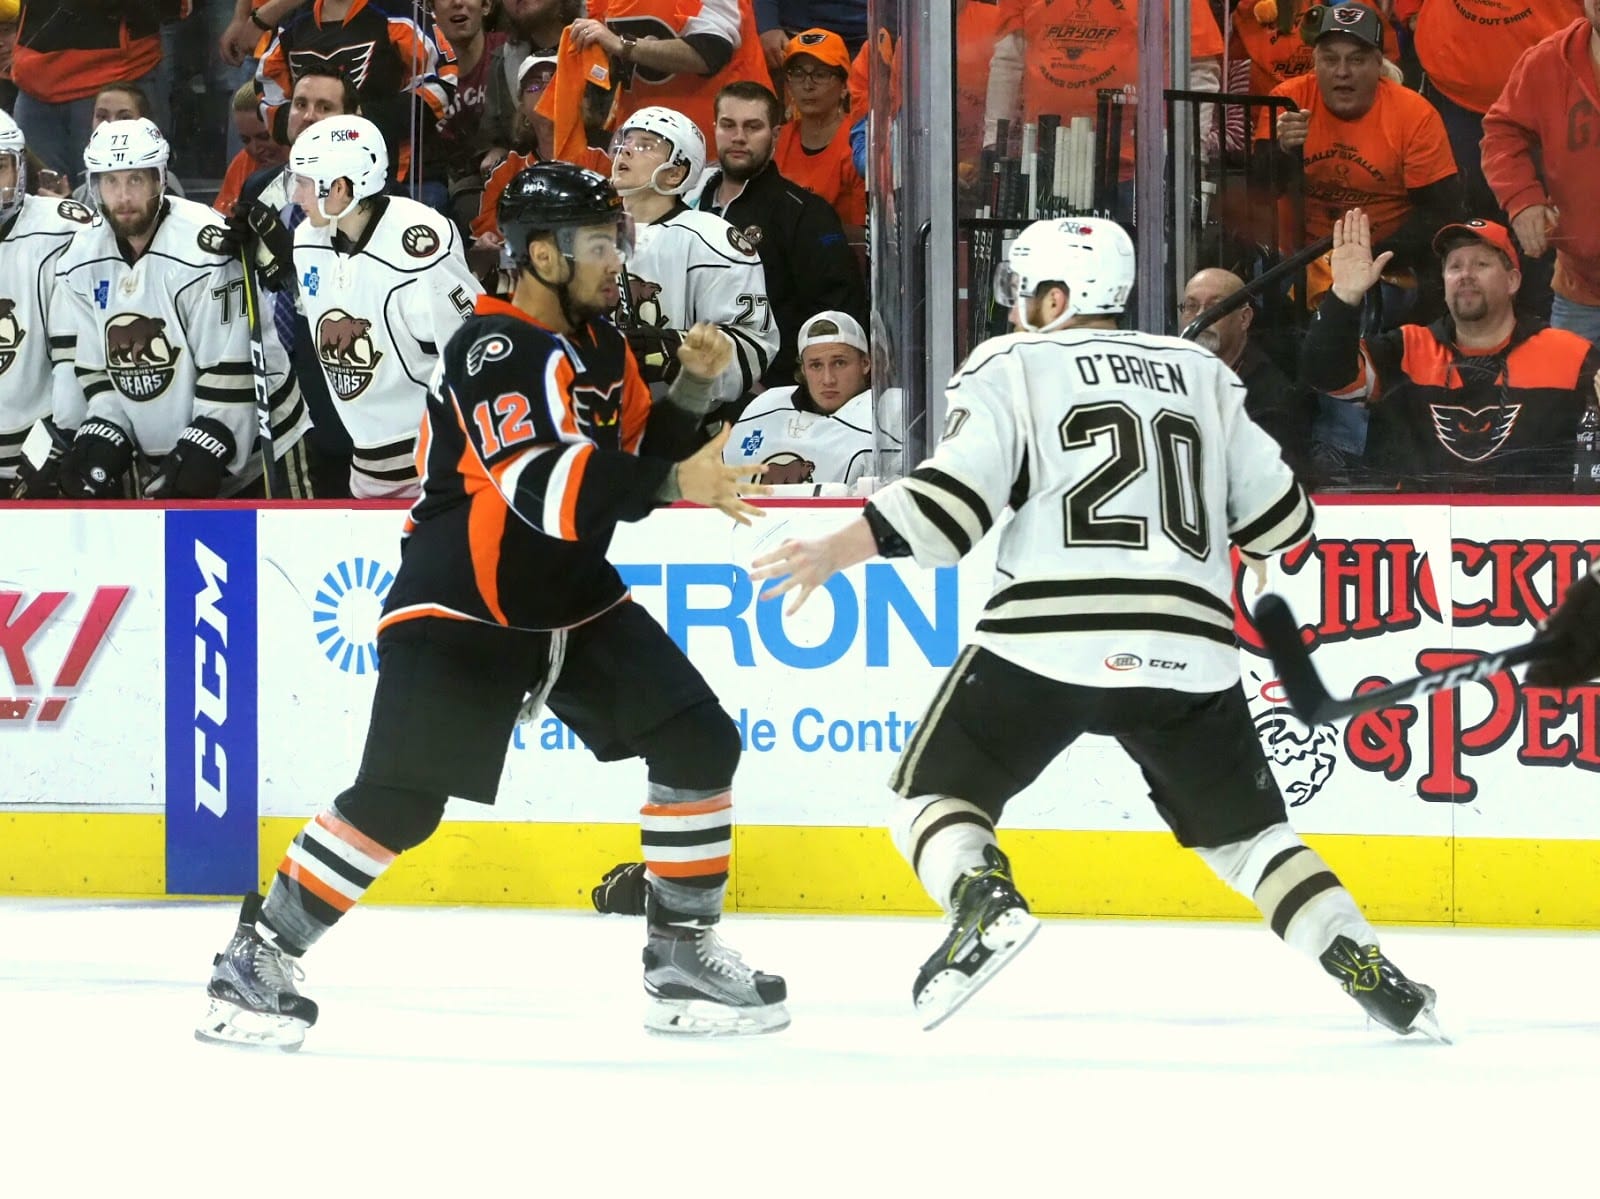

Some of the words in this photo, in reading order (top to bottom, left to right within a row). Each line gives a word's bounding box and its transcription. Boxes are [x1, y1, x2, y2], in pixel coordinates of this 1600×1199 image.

[1046, 26, 1117, 39] PLAYOFF
[1478, 17, 1500, 25] OUT
[111, 134, 128, 147] 77
[210, 276, 249, 325] 77
[731, 293, 772, 334] 27
[119, 374, 163, 396] BEARS
[250, 340, 272, 440] CCM
[1075, 354, 1189, 396] O'BRIEN
[473, 391, 536, 461] 12
[1058, 400, 1211, 563] 20
[194, 538, 228, 819] CCM
[1148, 658, 1188, 671] CCM
